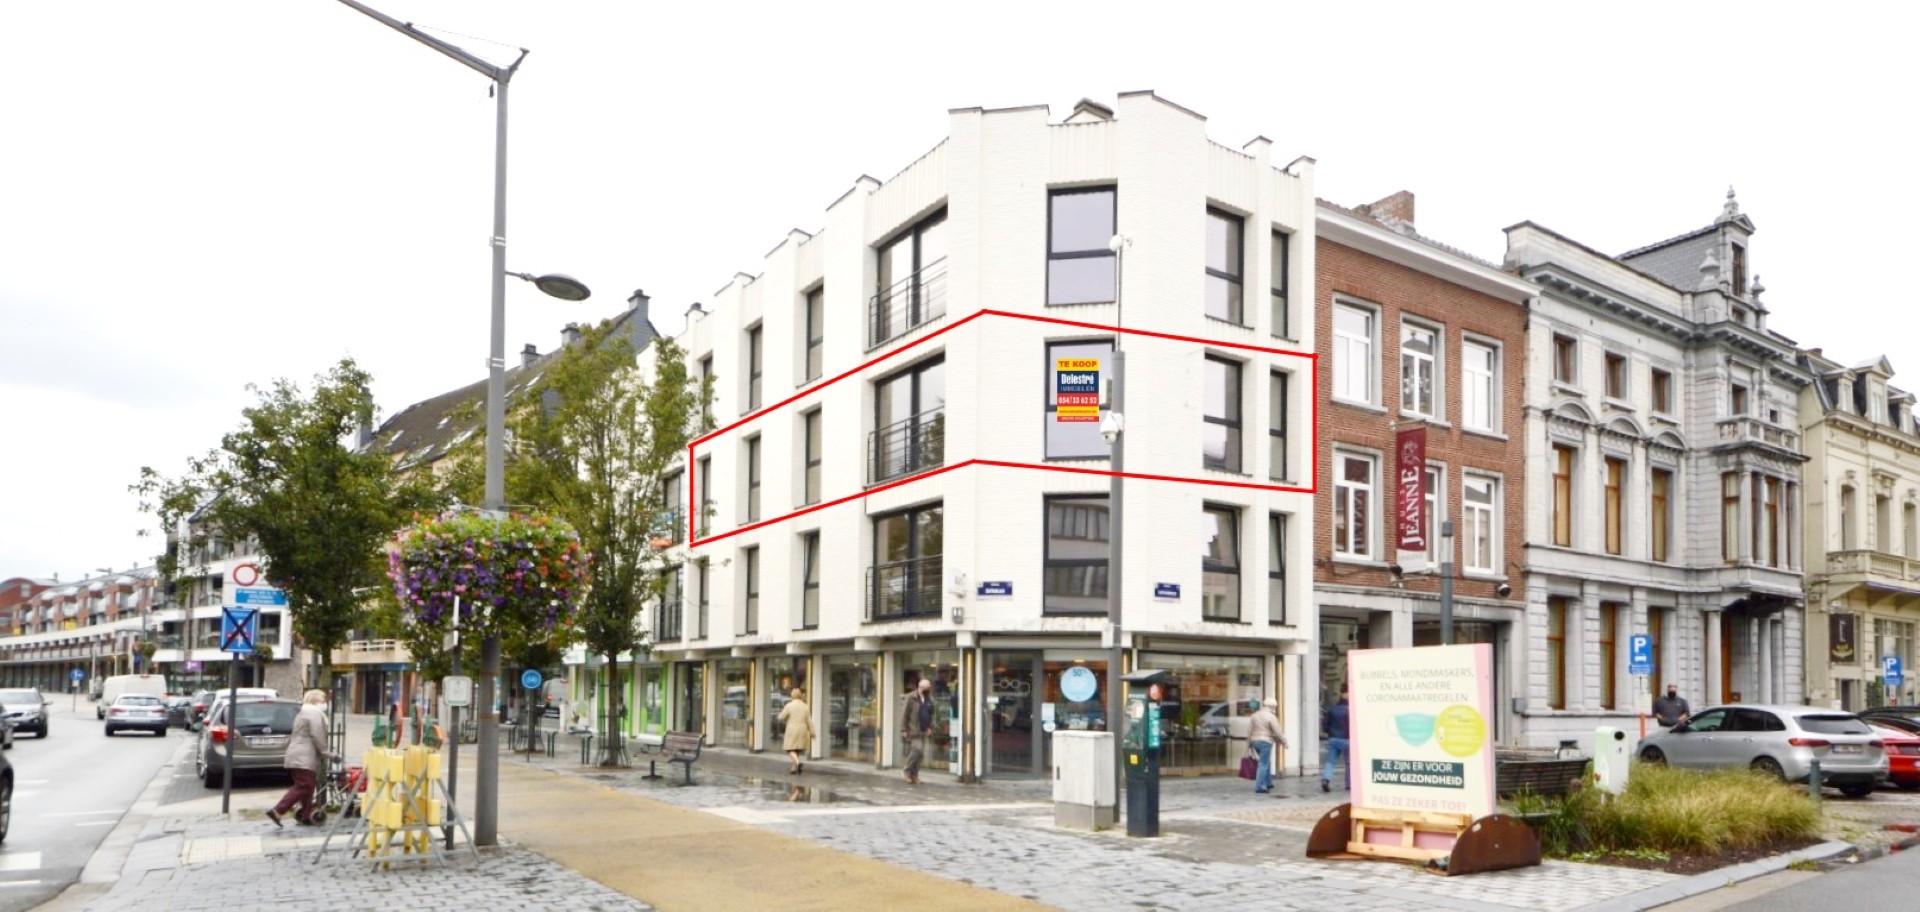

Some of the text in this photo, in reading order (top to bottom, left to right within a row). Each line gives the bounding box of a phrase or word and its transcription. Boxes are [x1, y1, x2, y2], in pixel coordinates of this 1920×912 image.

[1061, 373, 1095, 385] Delestré
[1401, 465, 1424, 546] JEANNE
[1634, 637, 1647, 653] P
[1400, 667, 1475, 678] MONDMASKERS,
[1380, 680, 1452, 691] EN ALLE ANDERE
[1366, 692, 1469, 703] CORONAMAATREGELEN
[1381, 760, 1453, 772] ZE ZIJN ER VOOR
[1373, 771, 1463, 786] JOUW GEZONDHEID
[1371, 795, 1466, 811] PAS ZE ZEKER TOE!
